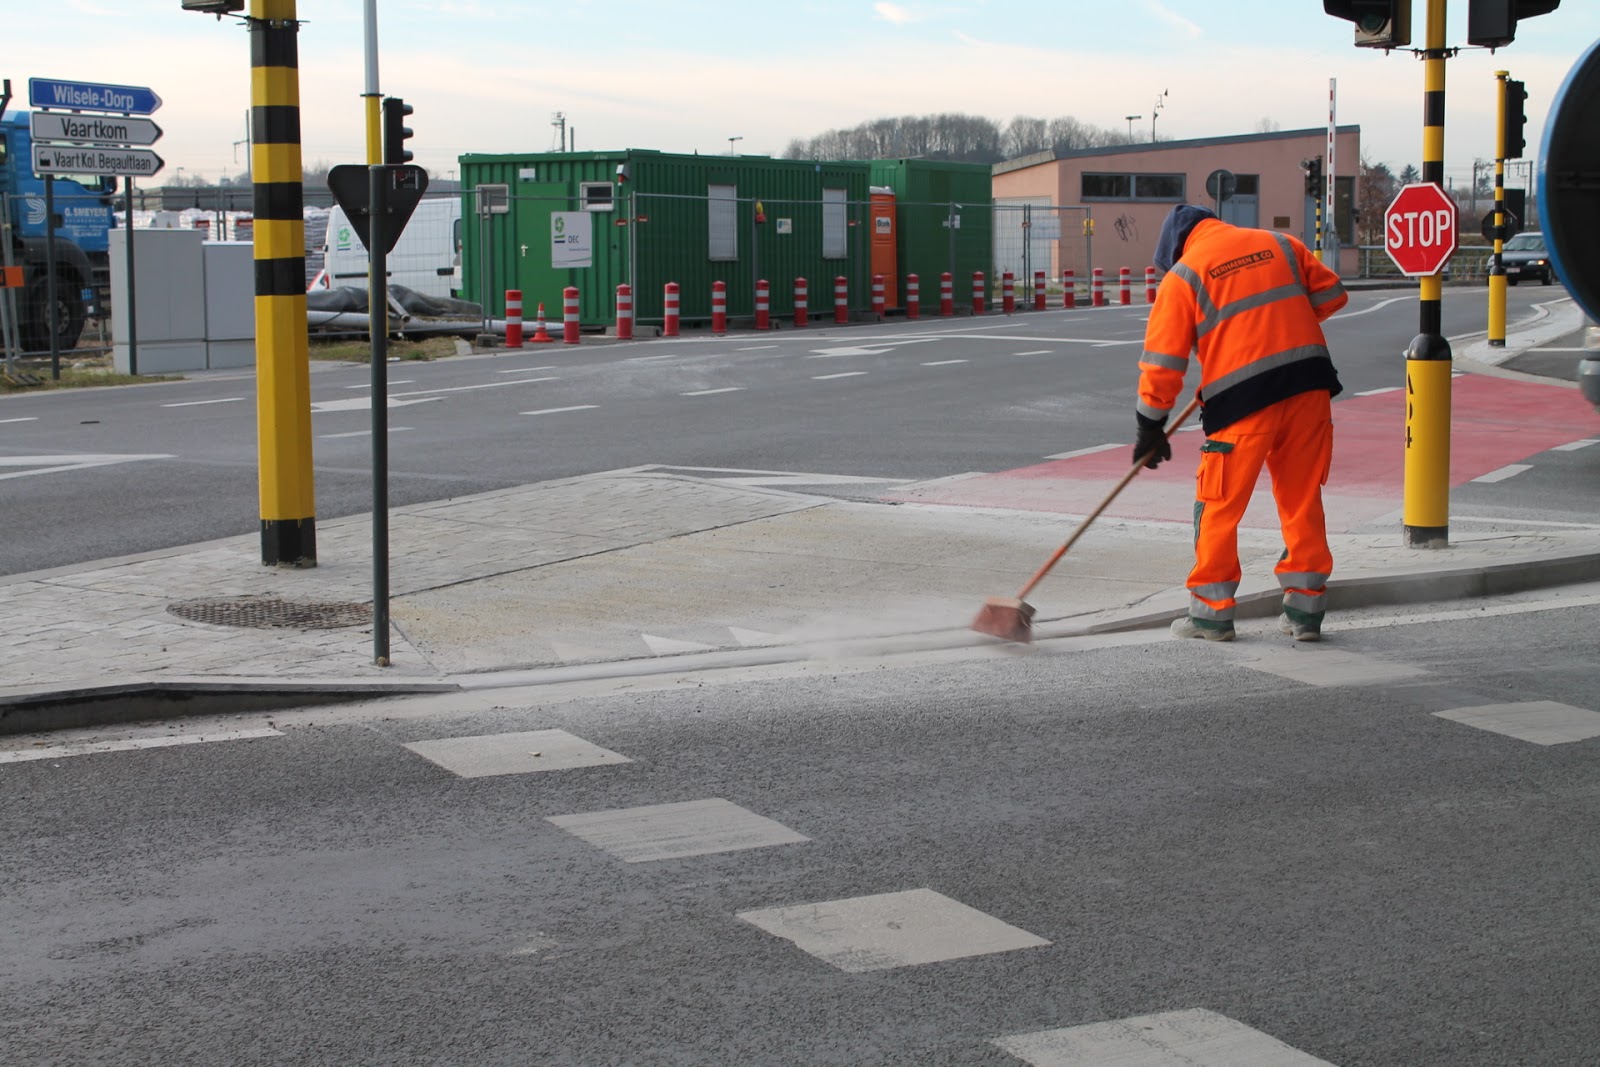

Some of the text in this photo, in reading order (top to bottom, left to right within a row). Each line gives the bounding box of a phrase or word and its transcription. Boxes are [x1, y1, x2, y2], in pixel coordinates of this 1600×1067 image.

[53, 85, 135, 111] Wilsele-Dorp
[61, 118, 128, 139] Vaartkom
[54, 151, 152, 173] Vaart Kol. Begaultlaan
[568, 235, 579, 244] DEC
[1389, 210, 1451, 249] STOP
[1211, 256, 1253, 277] VERHAEREN
[1253, 254, 1260, 262] &
[1260, 251, 1272, 259] CO
